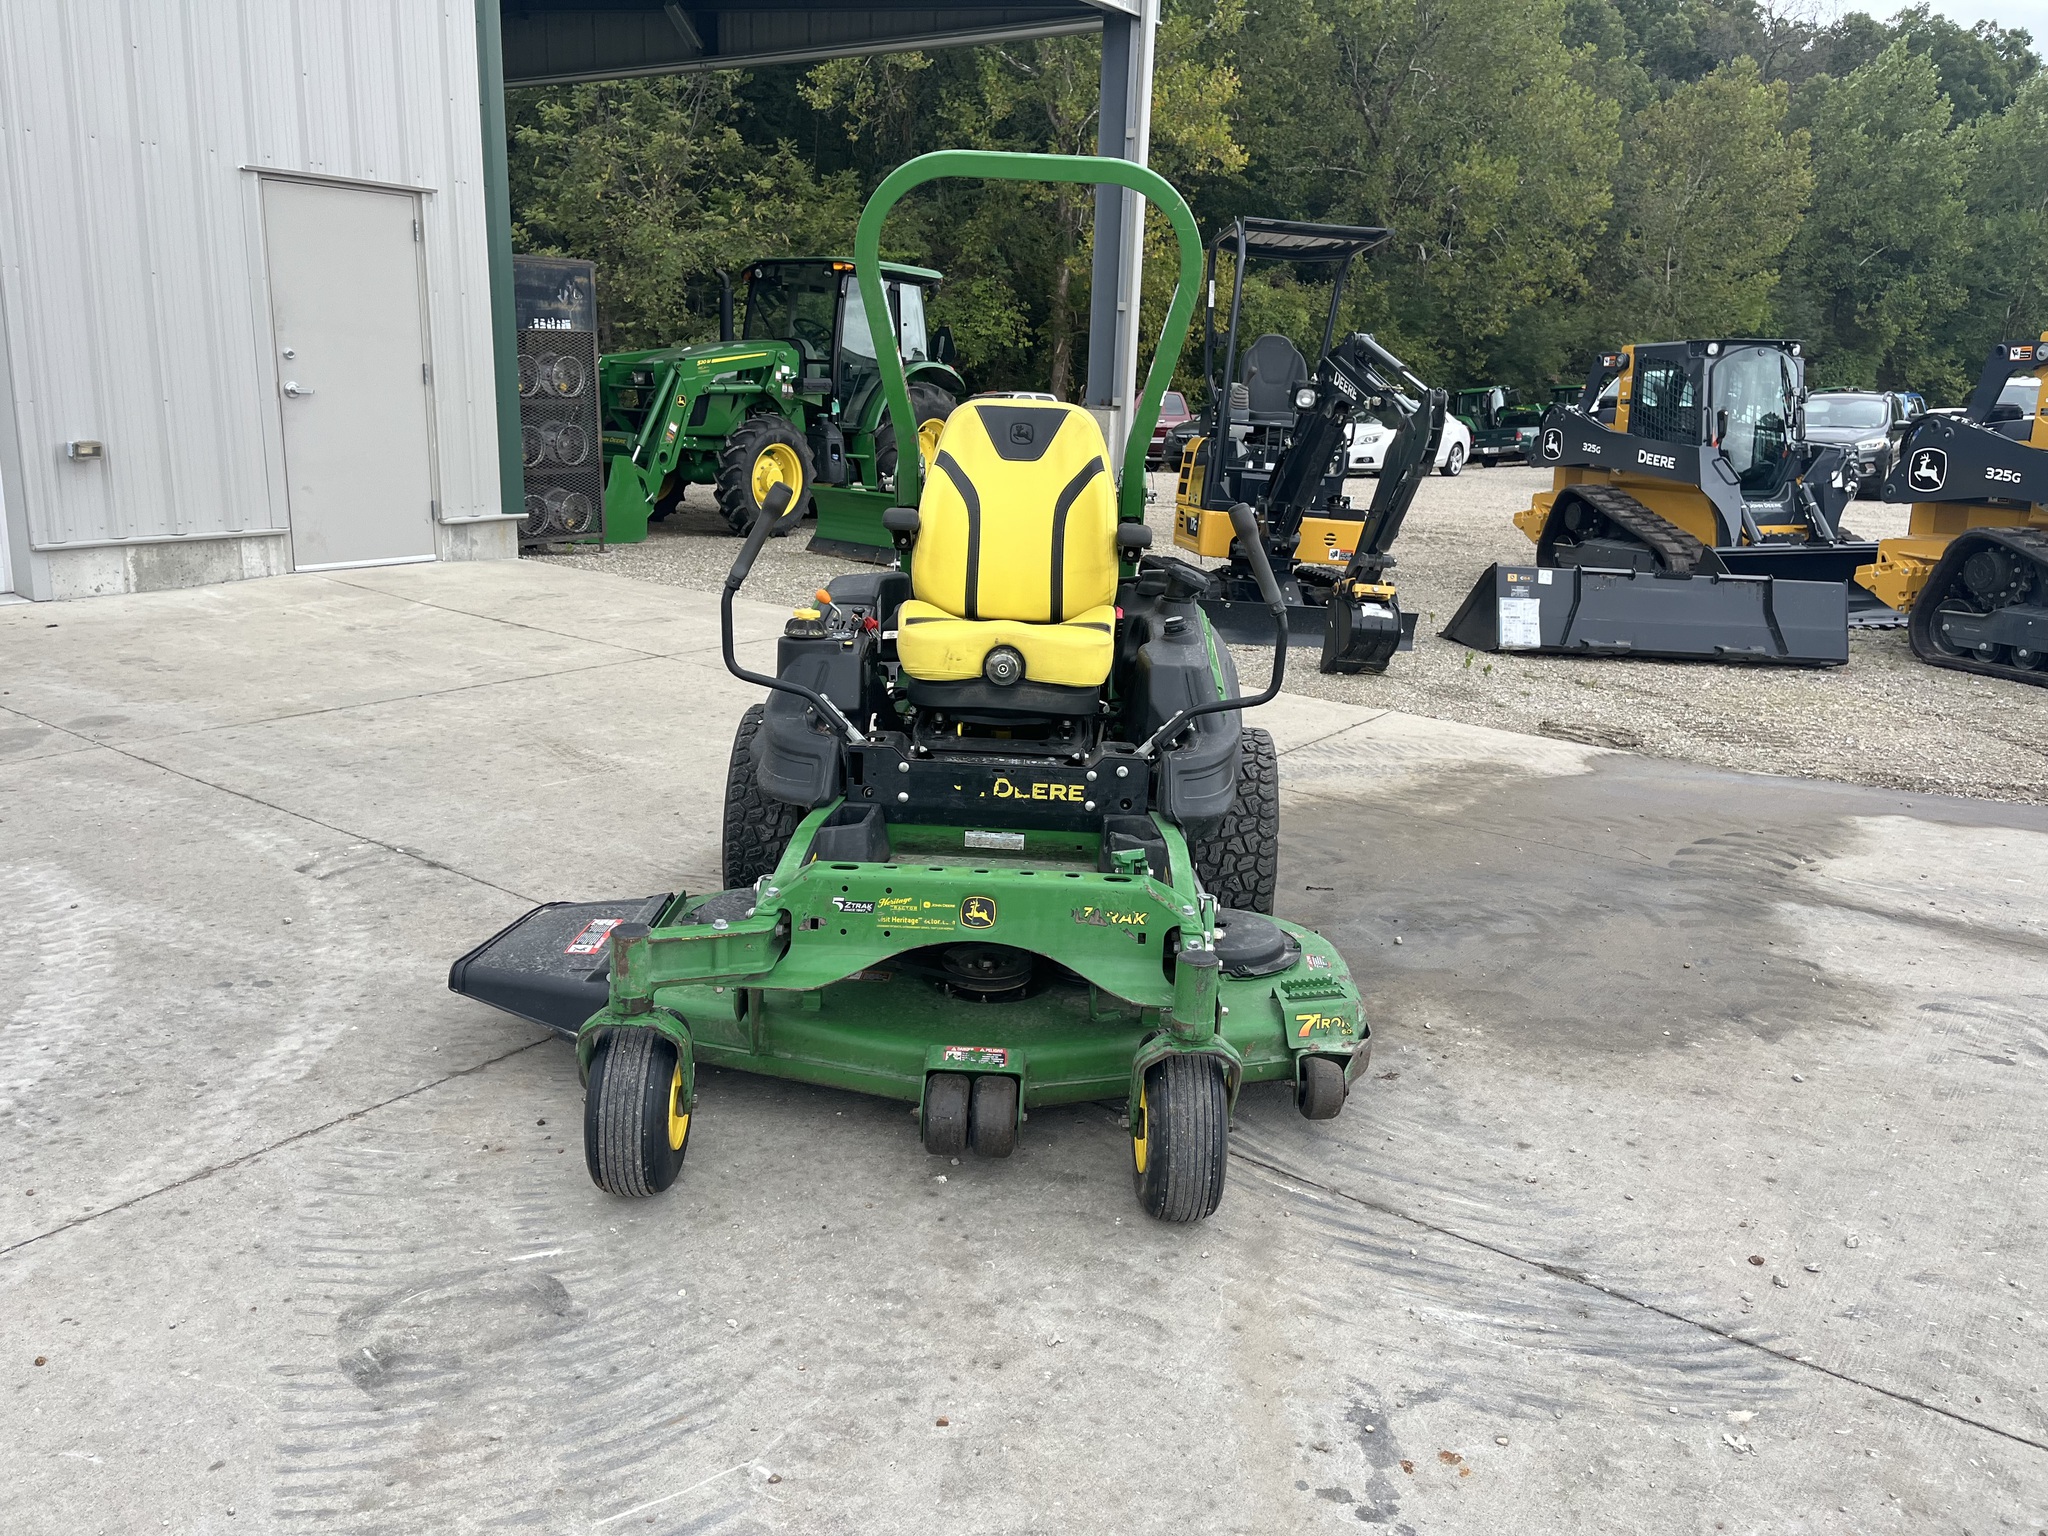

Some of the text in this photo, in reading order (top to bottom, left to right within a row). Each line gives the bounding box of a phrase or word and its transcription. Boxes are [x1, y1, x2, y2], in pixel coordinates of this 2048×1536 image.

[1333, 371, 1357, 401] DEERE
[1582, 442, 1601, 454] 325G
[1637, 449, 1676, 469] DEERE
[1985, 467, 2021, 483] 325G
[844, 901, 873, 911] ZTRAK
[878, 897, 912, 908] Heritage
